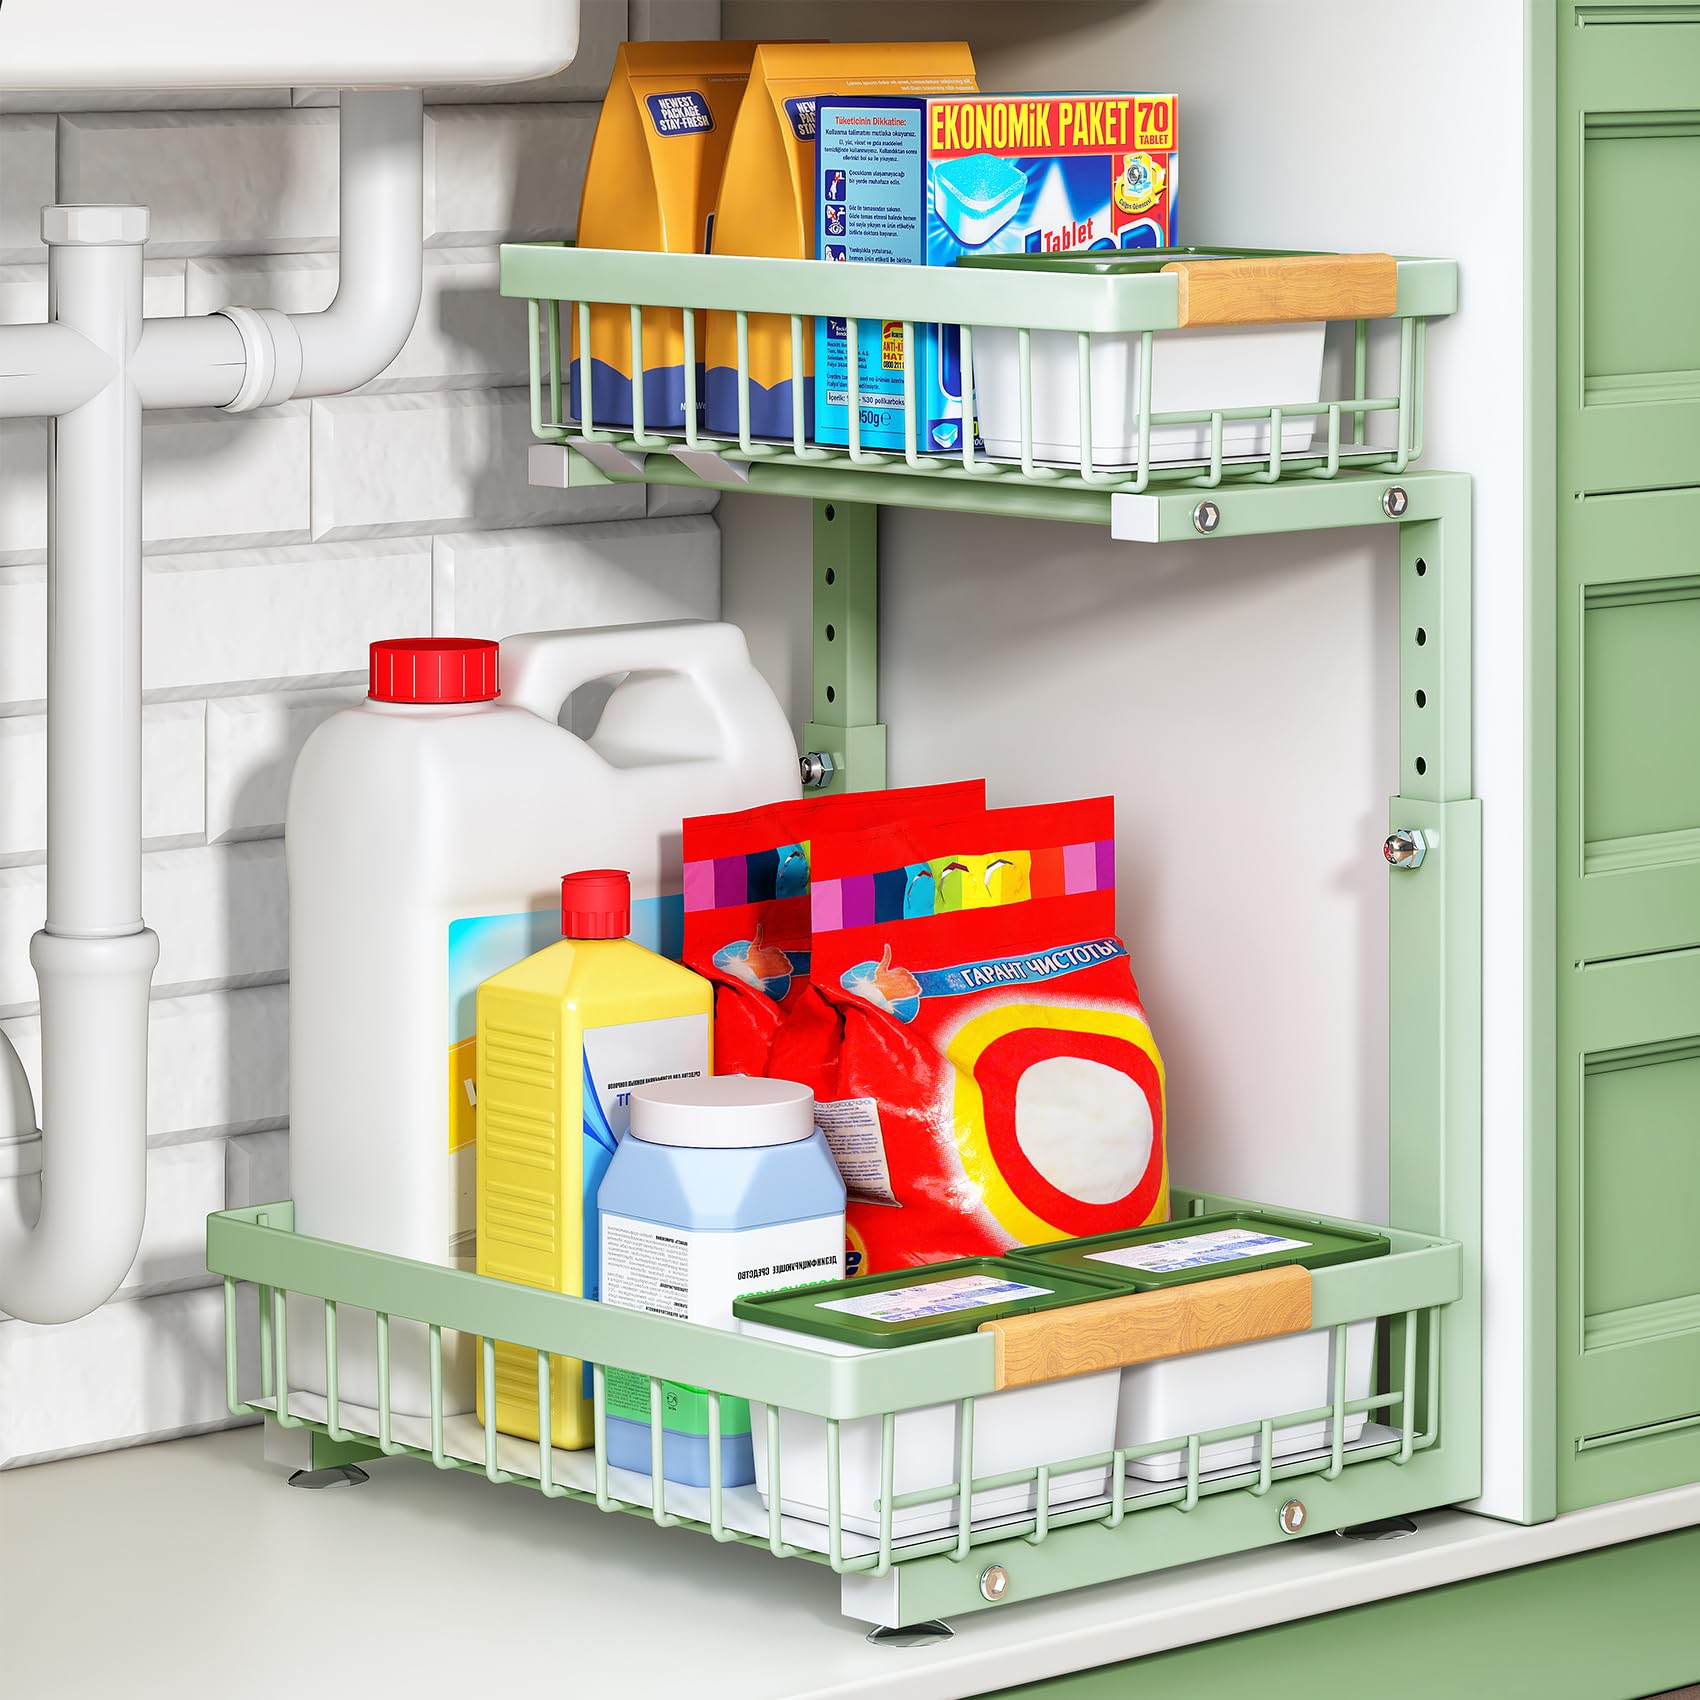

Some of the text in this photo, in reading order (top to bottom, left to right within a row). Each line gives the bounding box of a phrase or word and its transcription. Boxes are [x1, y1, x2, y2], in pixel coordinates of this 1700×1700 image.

[658, 96, 694, 109] NEWEST
[661, 105, 700, 119] PACKAGE
[1138, 101, 1169, 132] 70
[659, 115, 710, 131] STAY-FRESH
[835, 116, 906, 126] Tüketicinin Dikkatine:
[1059, 101, 1129, 146] PAKET
[1139, 134, 1169, 146] TABLET
[1044, 217, 1094, 252] Tablet
[960, 940, 1118, 988] ГАРАНТ ЧИСТОТЫ
